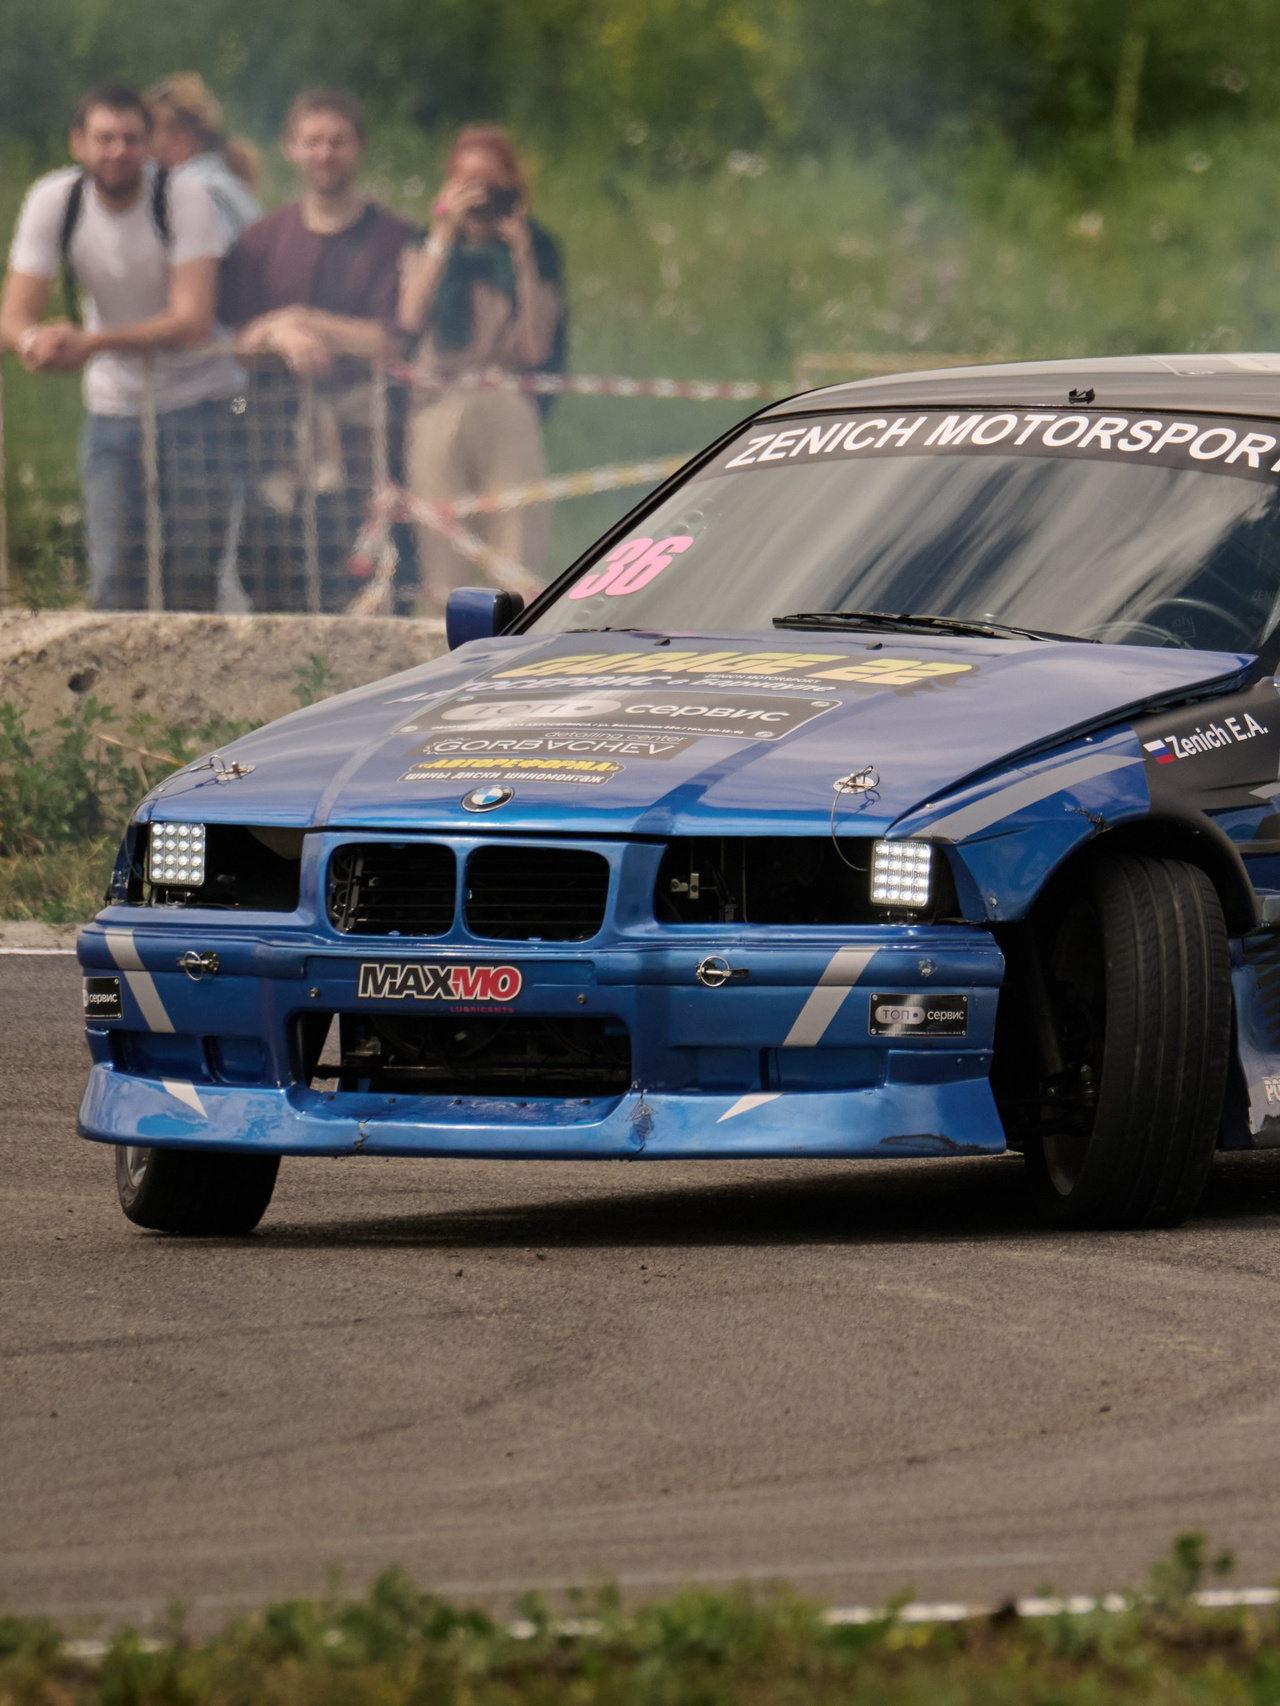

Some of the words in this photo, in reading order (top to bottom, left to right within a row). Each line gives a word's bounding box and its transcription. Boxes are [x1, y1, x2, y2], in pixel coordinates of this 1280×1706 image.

[725, 416, 926, 469] ZENICH
[568, 536, 694, 600] 36
[491, 651, 850, 679] GARAGE
[804, 658, 973, 685] 22
[475, 703, 567, 717] ТОП
[624, 703, 790, 722] сервис
[631, 734, 688, 743] center
[1164, 723, 1232, 759] Zenich
[358, 963, 522, 1002] MAXMO
[89, 993, 118, 1005] сервис
[450, 1006, 515, 1014] LUBRICANTS
[882, 1009, 910, 1020] ТОП
[926, 1010, 965, 1022] сервис
